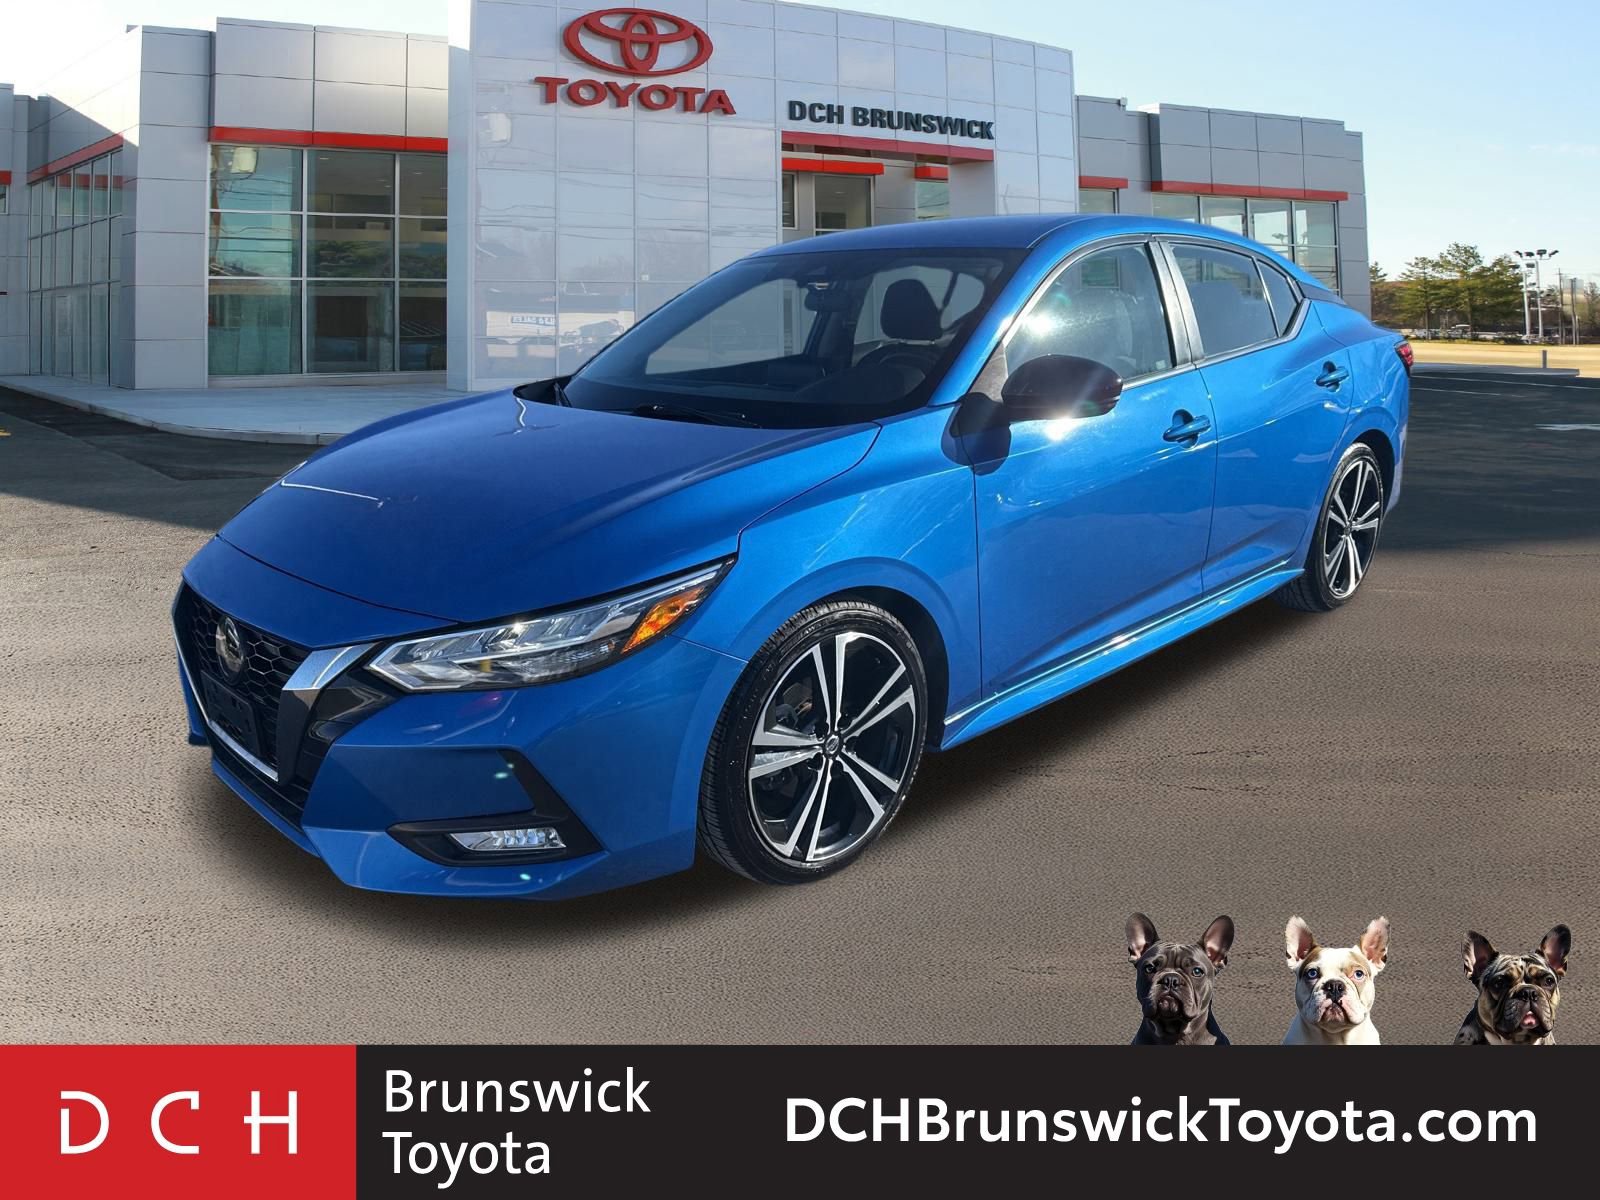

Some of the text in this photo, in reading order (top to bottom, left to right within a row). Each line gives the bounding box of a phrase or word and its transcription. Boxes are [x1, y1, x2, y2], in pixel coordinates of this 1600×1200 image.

[534, 76, 736, 115] TOYOTA
[788, 100, 995, 141] DCH BRUNSWICK
